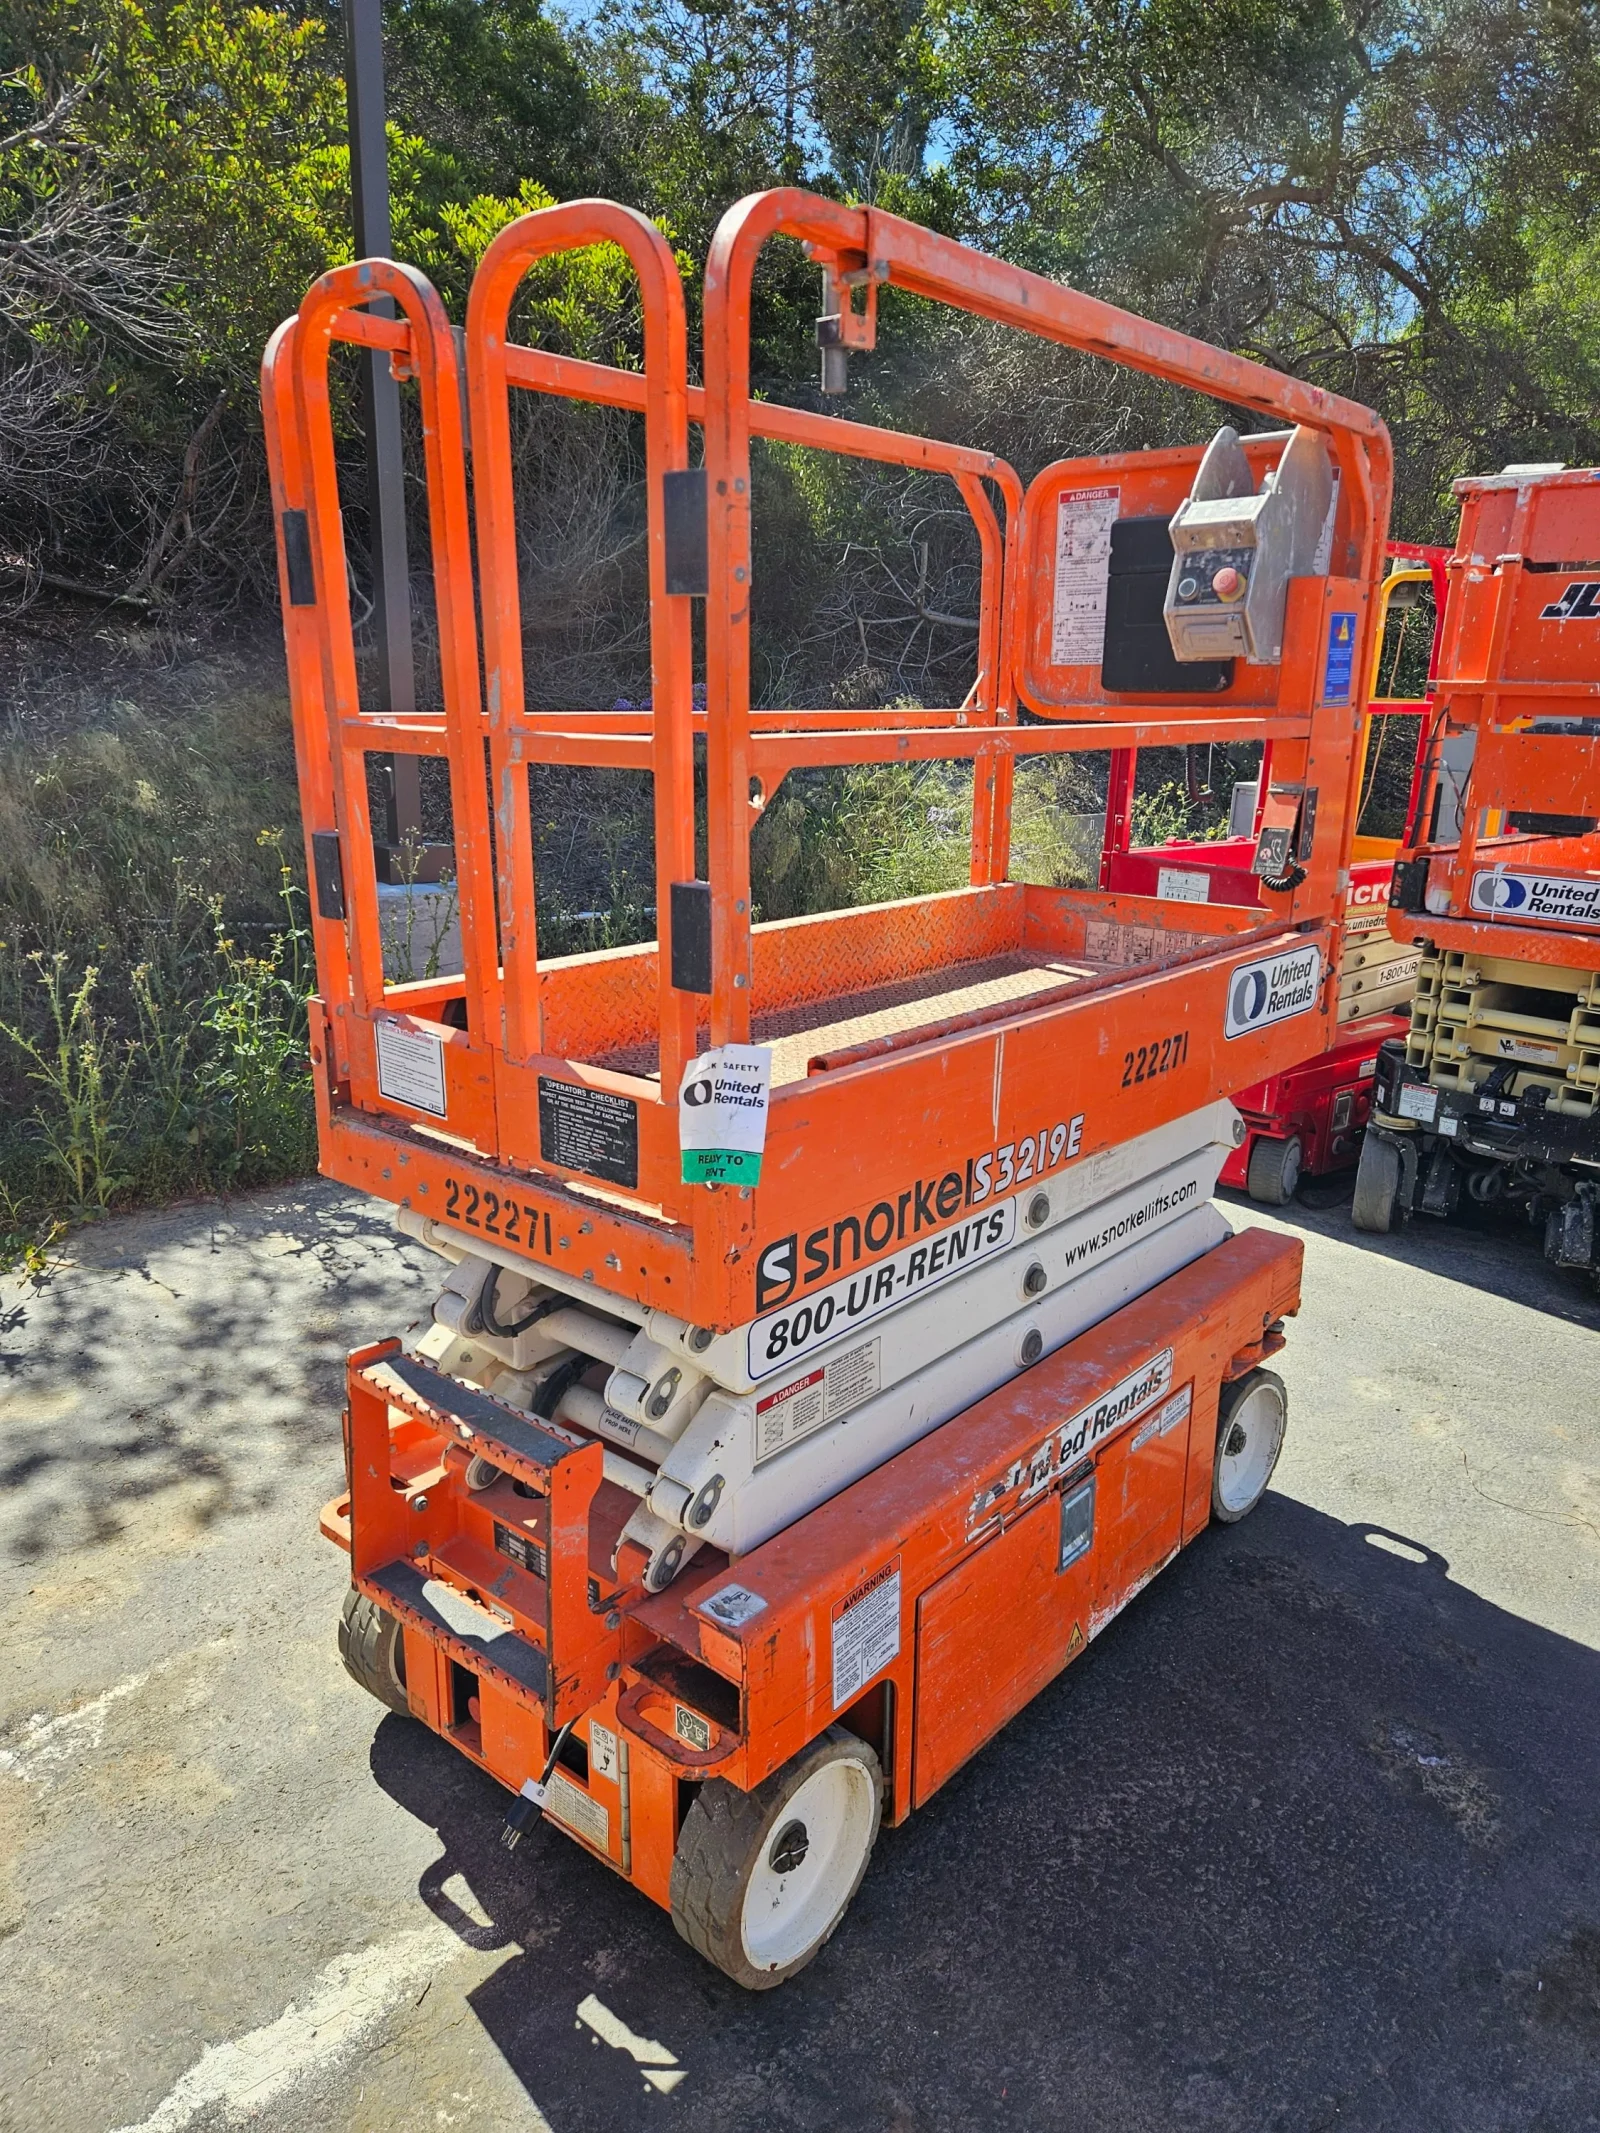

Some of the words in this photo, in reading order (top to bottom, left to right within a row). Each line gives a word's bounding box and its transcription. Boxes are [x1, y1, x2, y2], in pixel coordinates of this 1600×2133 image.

[1076, 490, 1109, 500] DANGER
[1538, 582, 1600, 619] JL
[1531, 882, 1600, 902] United
[1528, 898, 1600, 919] Rentals
[1271, 954, 1314, 988] United
[1380, 961, 1418, 982] 1-800-UR
[1266, 980, 1313, 1014] Rentals
[724, 1062, 760, 1072] SAFETY
[1122, 1030, 1188, 1088] 222271
[547, 1080, 586, 1097] OPERATORS
[591, 1091, 629, 1108] CHECKLIST
[714, 1079, 761, 1094] United
[714, 1093, 765, 1108] Rentals
[726, 1154, 744, 1166] TO
[972, 1112, 1085, 1204] S3219E
[445, 1178, 552, 1256] 222271
[804, 1158, 974, 1284] snorkel
[1065, 1180, 1197, 1268] www.snorkellifts.com
[766, 1208, 1005, 1360] 800-UR-RENTS
[779, 1376, 810, 1400] DANGER
[605, 1418, 618, 1428] PROP
[618, 1426, 632, 1436] HERE
[606, 1410, 620, 1420] PLACE
[620, 1416, 639, 1428] SAFETY
[848, 1565, 892, 1606] WARNING
